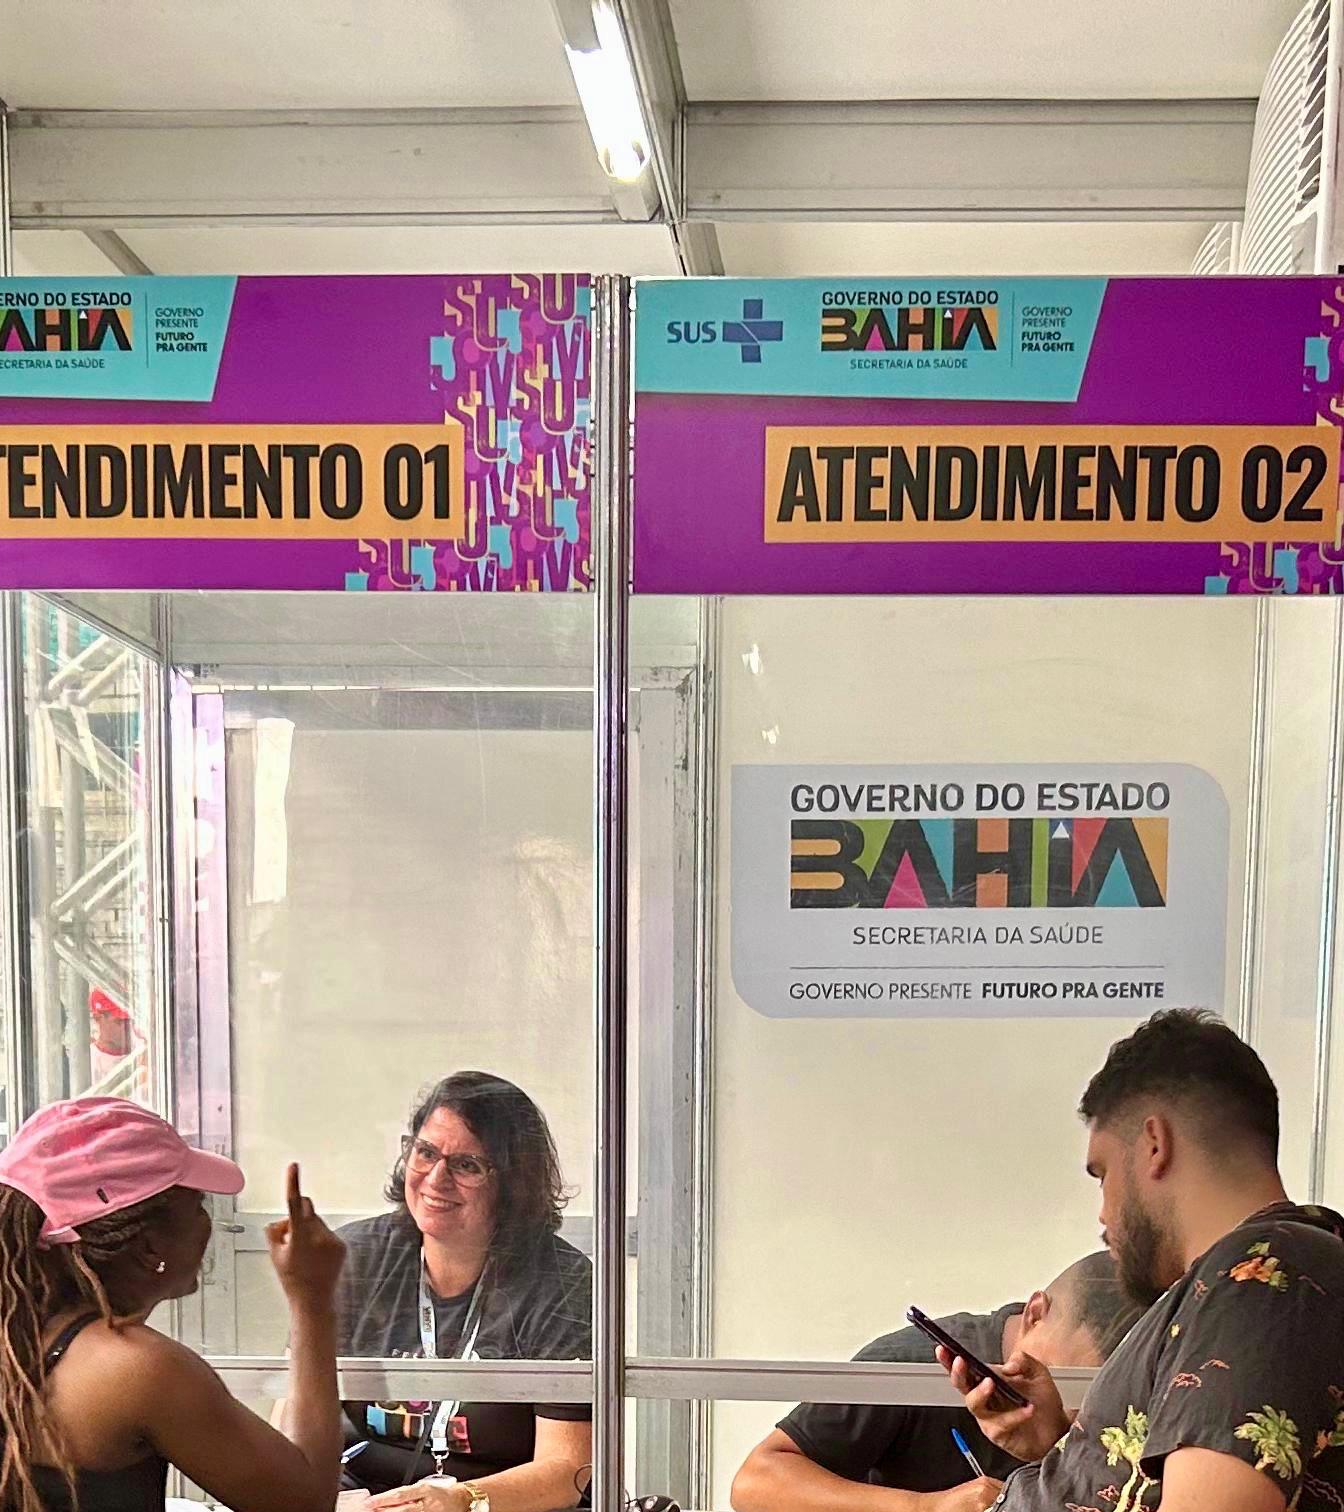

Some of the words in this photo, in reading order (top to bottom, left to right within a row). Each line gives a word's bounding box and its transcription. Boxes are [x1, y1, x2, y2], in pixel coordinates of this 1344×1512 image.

[44, 292, 67, 306] DO
[71, 292, 132, 306] ESTADO
[822, 291, 903, 306] GOVERNO
[908, 291, 931, 304] DO
[937, 291, 998, 304] ESTADO
[156, 308, 204, 317] GOVERNO
[1022, 306, 1072, 316] GOVERNO
[156, 318, 198, 328] PRESENTE
[821, 308, 997, 351] BAHIA
[1022, 318, 1066, 328] PRESENTE
[156, 332, 194, 341] FUTURO
[667, 321, 717, 343] SUS
[1022, 331, 1061, 341] FUTURO
[156, 343, 174, 352] PRA
[176, 342, 208, 352] GENTE
[1022, 342, 1041, 352] PRA
[1043, 342, 1074, 352] GENTE
[55, 359, 69, 369] DA
[71, 357, 105, 369] SAÚDE
[850, 359, 913, 369] SECRETARIA
[917, 359, 931, 369] DA
[933, 357, 968, 369] SAÚDE
[383, 443, 450, 521] 01
[776, 444, 1221, 523] ATENDIMENTO
[1242, 444, 1327, 523] 02
[791, 782, 964, 813] GOVERNO
[976, 782, 1024, 811] DO
[1037, 781, 1170, 811] ESTADO
[790, 817, 1168, 909] BAHIA
[853, 927, 987, 945] SECRETARIA
[995, 927, 1024, 945] DA
[1030, 921, 1103, 945] SAÚDE
[790, 983, 883, 1000] GOVERNO
[890, 983, 971, 999] PRESENTE
[982, 982, 1057, 999] FUTURO
[1062, 982, 1098, 999] PRA
[1103, 982, 1164, 999] GENTE
